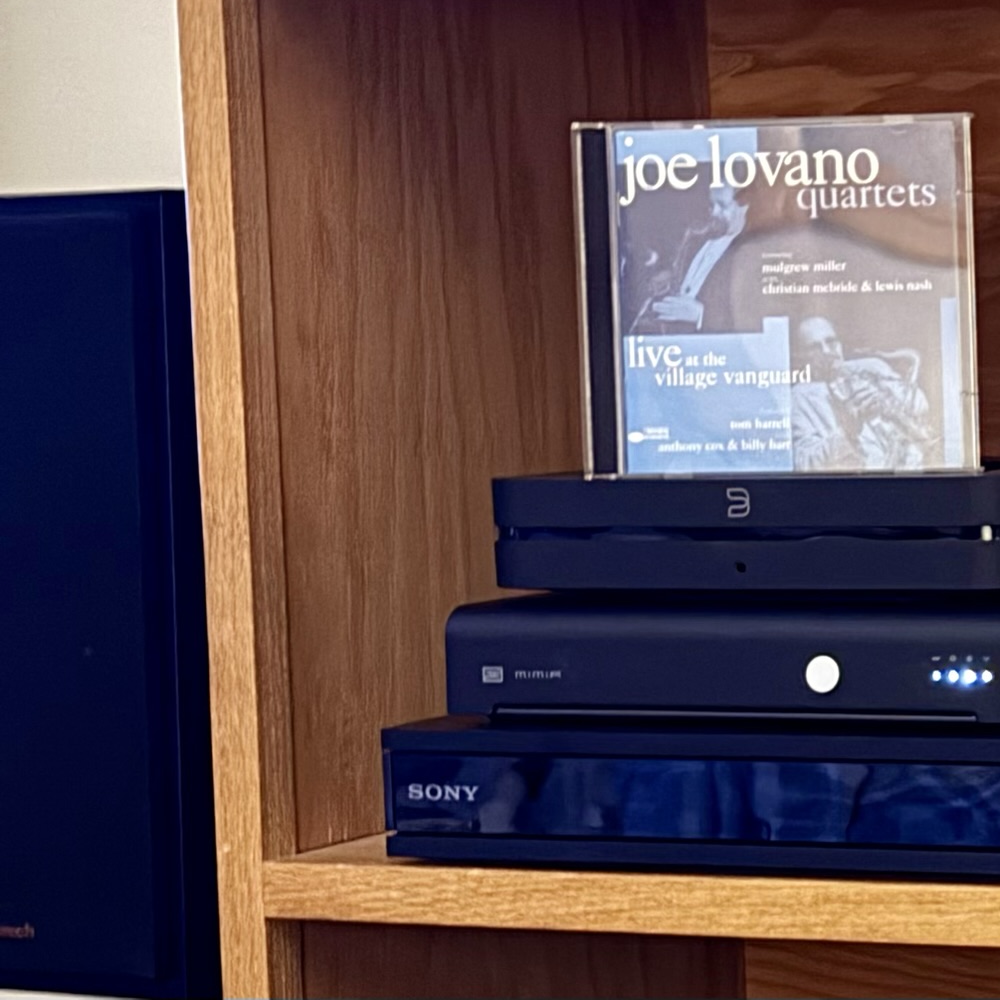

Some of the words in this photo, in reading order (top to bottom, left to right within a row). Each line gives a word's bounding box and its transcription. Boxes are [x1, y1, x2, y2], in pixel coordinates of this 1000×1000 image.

[619, 136, 699, 206] joe
[707, 134, 880, 189] lovano
[796, 181, 937, 220] quartets
[762, 261, 810, 275] mulgrew
[813, 259, 847, 272] miller
[762, 280, 810, 295] christian
[813, 280, 859, 294] mcbride
[861, 280, 873, 293] &
[875, 279, 904, 292] lewis
[906, 279, 933, 292] nash
[628, 335, 683, 369] live
[685, 354, 698, 367] at
[702, 351, 727, 367] the
[655, 366, 718, 391] village
[723, 364, 812, 389] vanguard
[730, 419, 752, 431] tom
[657, 439, 702, 455] anthony
[727, 438, 739, 452] &
[741, 438, 767, 454] billy
[768, 437, 792, 451] hart
[408, 782, 480, 802] SONY
